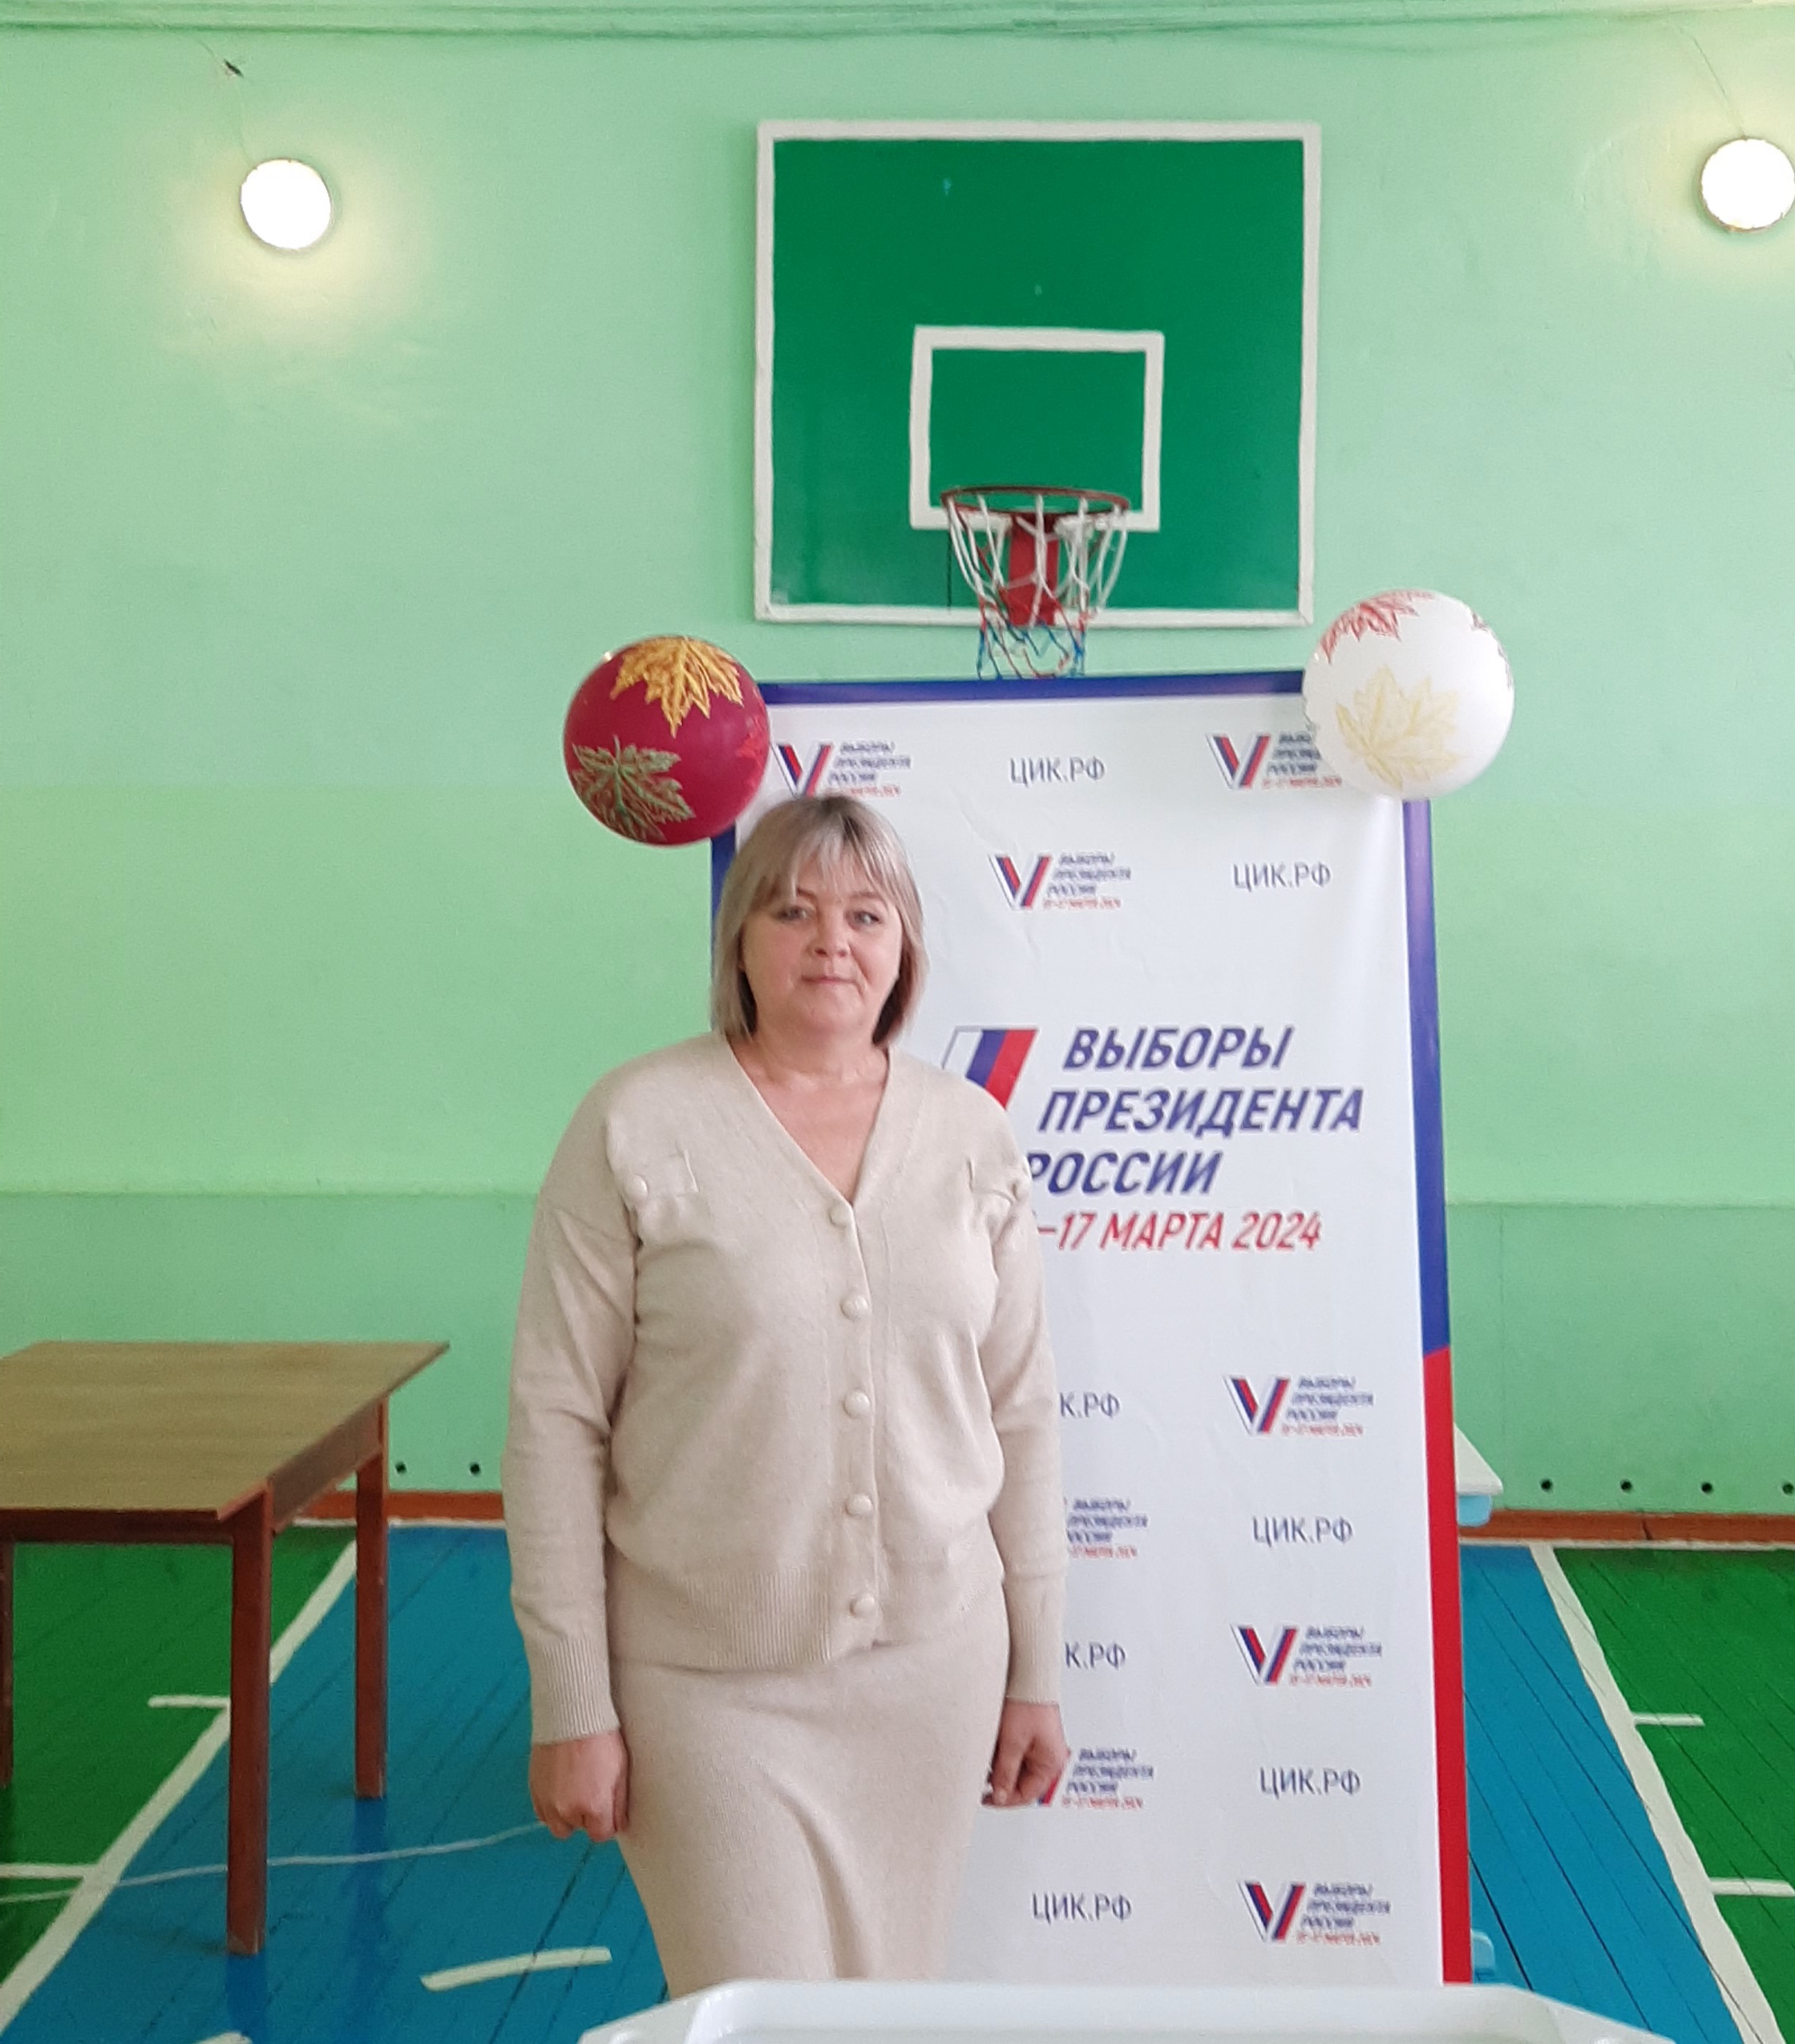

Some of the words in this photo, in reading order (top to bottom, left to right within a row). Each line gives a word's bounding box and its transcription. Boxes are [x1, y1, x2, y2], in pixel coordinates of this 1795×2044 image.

[1010, 756, 1105, 787] ЦИК.РФ
[1232, 862, 1332, 893] ЦИК.РФ
[1063, 1026, 1295, 1071] ВЫБОРЫ
[1037, 1089, 1364, 1139] ПРЕЗИДЕНТА
[1027, 1151, 1223, 1195] РОССИИ
[1099, 1212, 1224, 1250] МАРТА
[1231, 1212, 1321, 1250] 2024
[1059, 1392, 1120, 1419] К.РФ
[1252, 1516, 1353, 1548] ЦИК.РФ
[1065, 1641, 1126, 1670] К.РФ
[1259, 1767, 1361, 1800] ЦИК.РФ
[1032, 1893, 1133, 1925] ЦИК.РФ
